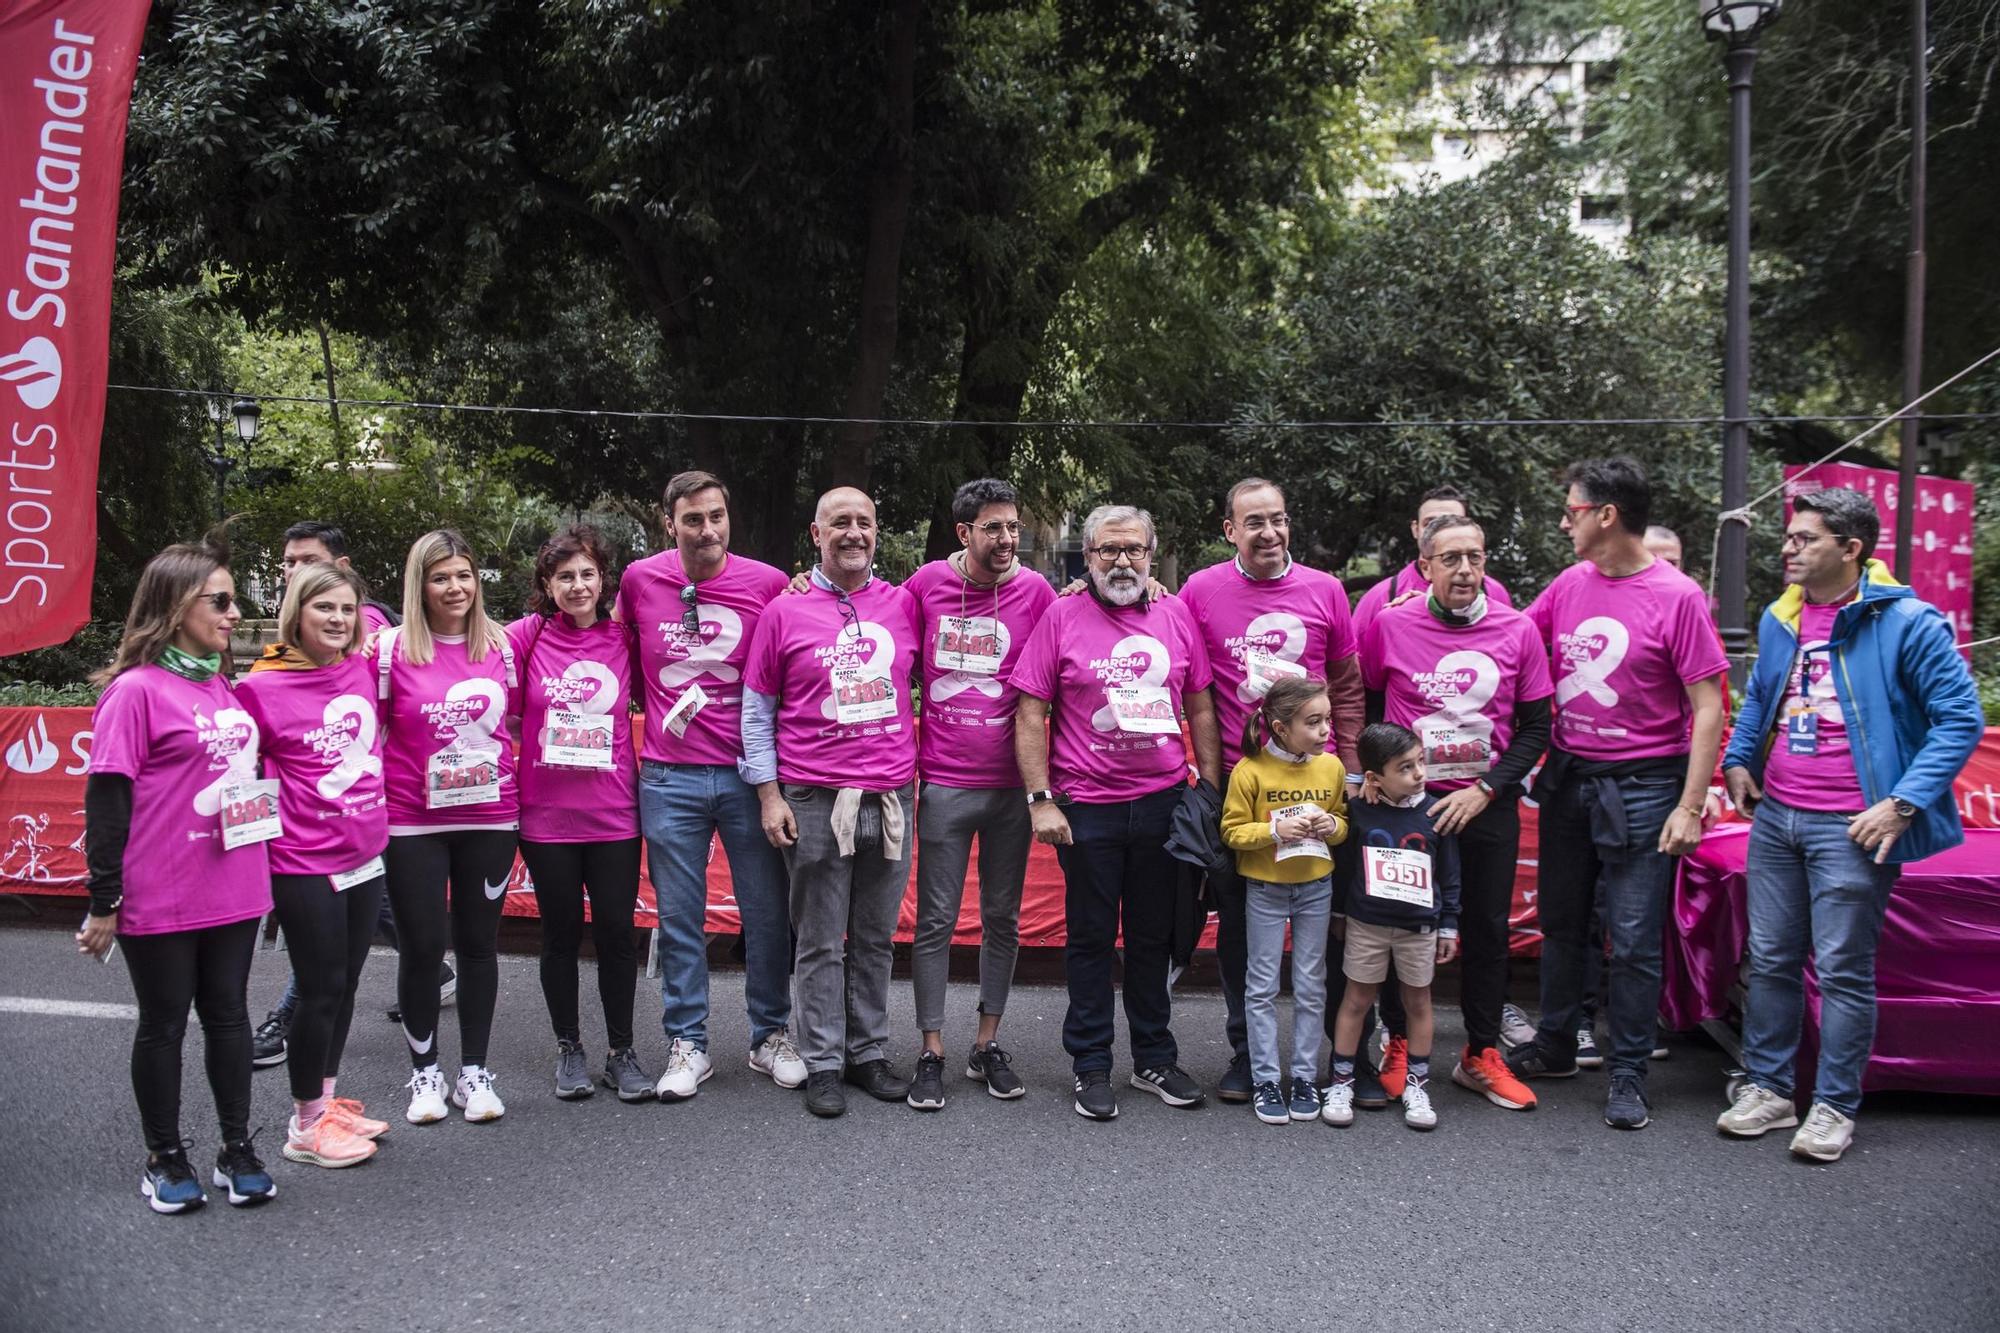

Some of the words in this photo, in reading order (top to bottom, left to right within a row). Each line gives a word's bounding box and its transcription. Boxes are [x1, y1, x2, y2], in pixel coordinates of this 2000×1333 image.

[8, 18, 96, 328] Santander
[0, 421, 65, 607] Sports
[658, 622, 714, 635] MARHA
[814, 642, 872, 658] MARCHA
[1089, 656, 1146, 669] MARCHA
[540, 676, 596, 691] MARCHA
[1411, 672, 1472, 683] MARCHA
[420, 699, 484, 714] MARCHA
[198, 726, 250, 744] MARCHA
[303, 717, 359, 745] MARCHA
[554, 726, 605, 751] 2740
[438, 764, 490, 790] 3679
[1266, 789, 1332, 803] ECOALF
[1382, 862, 1423, 887] 6151
